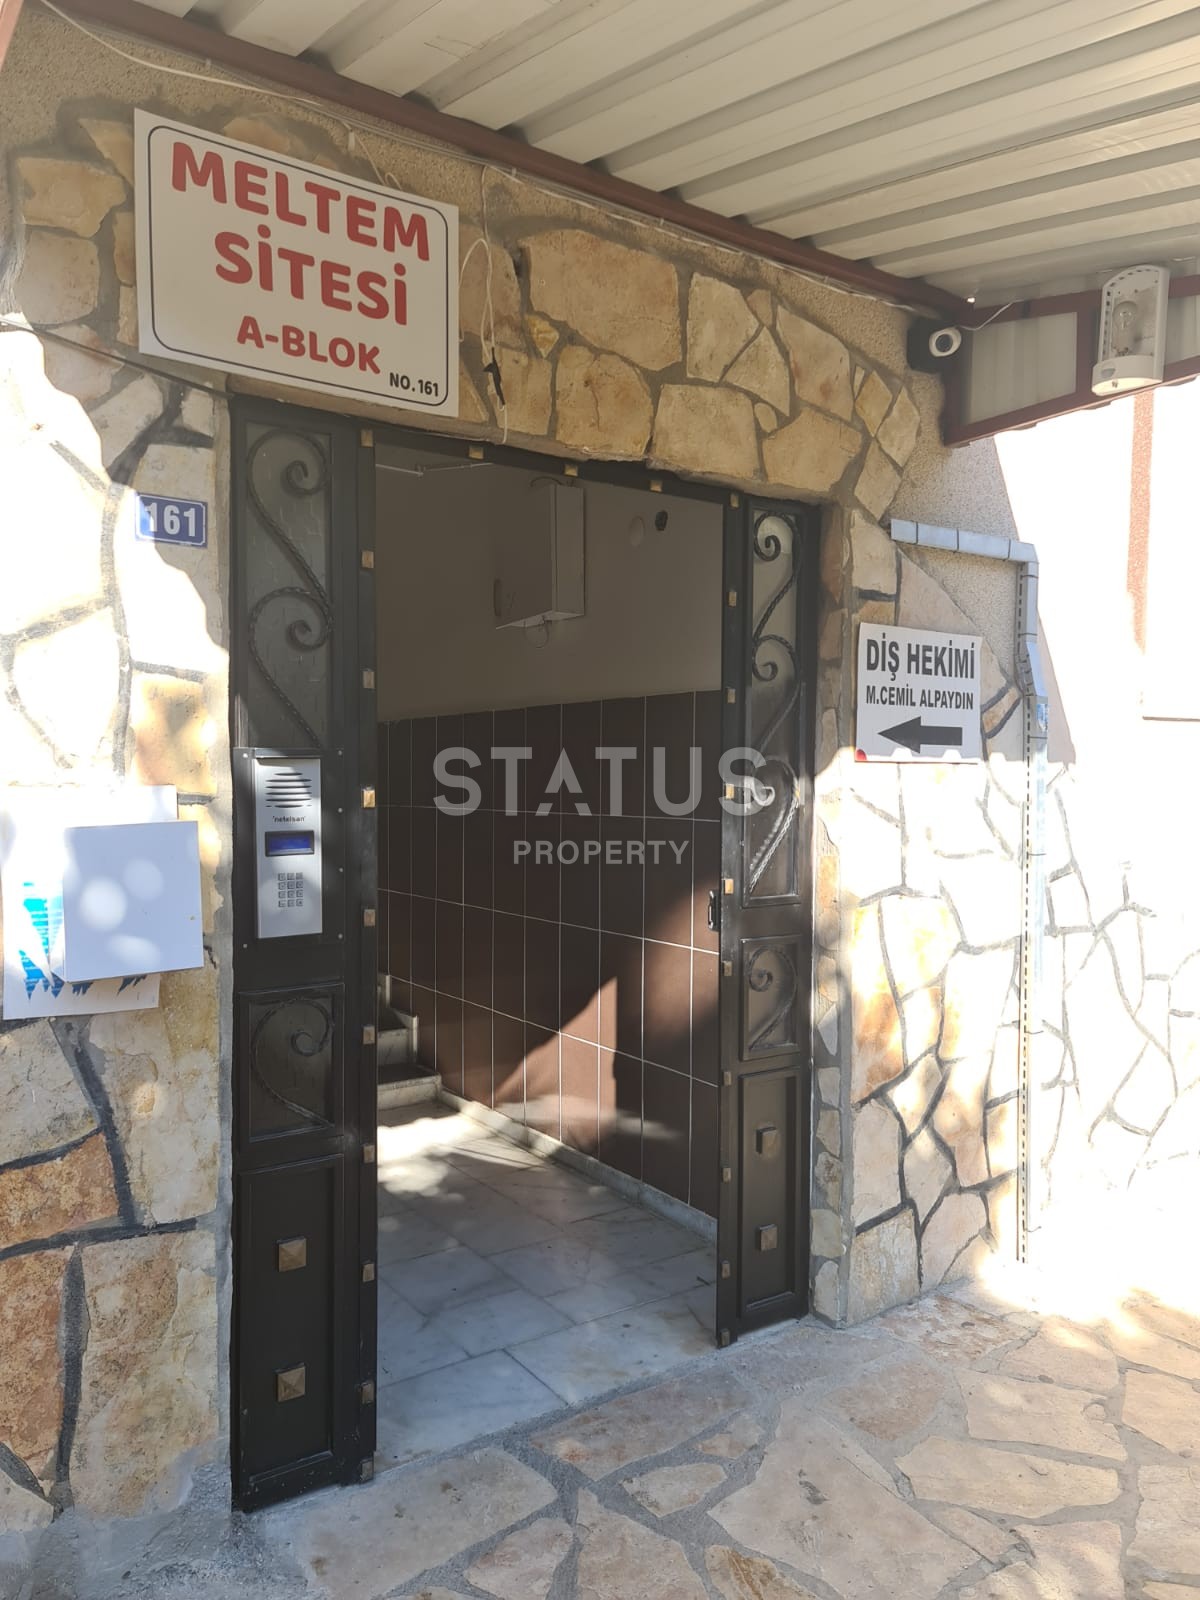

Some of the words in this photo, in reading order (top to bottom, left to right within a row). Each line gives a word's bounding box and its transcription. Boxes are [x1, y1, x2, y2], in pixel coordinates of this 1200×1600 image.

[171, 141, 430, 262] MELTEM
[214, 224, 408, 326] SİTESİ
[236, 315, 381, 375] A-BLOK
[144, 502, 196, 537] 161
[866, 632, 900, 681] DİŞ
[907, 640, 975, 679] HEKİMİ
[866, 683, 916, 707] M.CEMİL
[919, 689, 974, 710] ALPAYDIN
